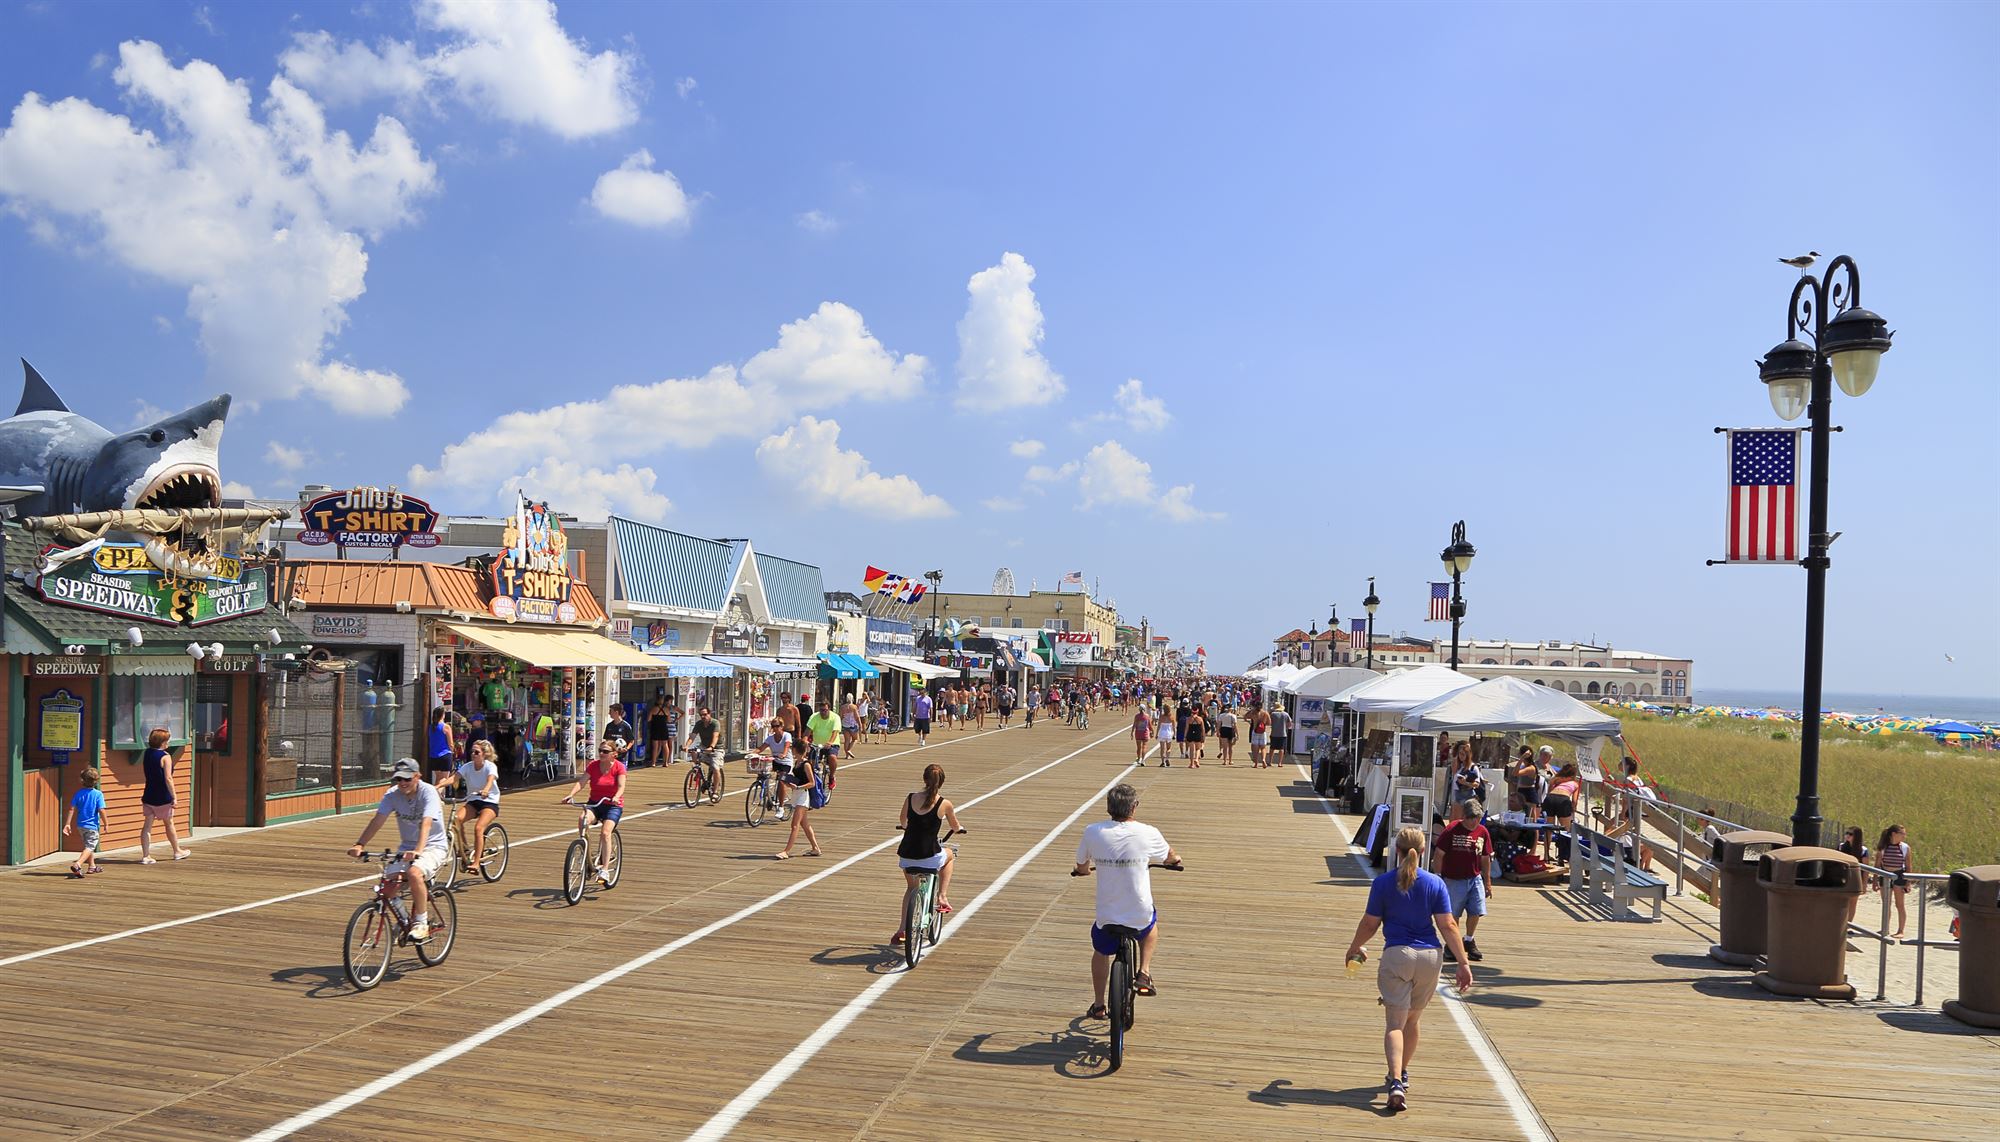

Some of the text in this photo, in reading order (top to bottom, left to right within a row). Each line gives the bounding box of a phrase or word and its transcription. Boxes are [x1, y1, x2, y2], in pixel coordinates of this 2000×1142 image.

[336, 487, 403, 509] Jilly's
[315, 511, 426, 531] T-SHIRT
[340, 532, 398, 542] FACTORY
[90, 572, 132, 590] SEASIDE
[502, 568, 570, 601] T-SHIRT
[55, 577, 161, 616] SPEEDWAY
[208, 581, 258, 599] SEAPORT VILLAGE
[216, 592, 251, 615] GOLF
[520, 600, 555, 616] FACTORY
[316, 616, 363, 627] DAVID'S
[615, 620, 629, 631] ATM
[1058, 631, 1093, 645] PIZZA
[36, 663, 101, 675] SPEEDWAY
[214, 661, 248, 671] GOLF
